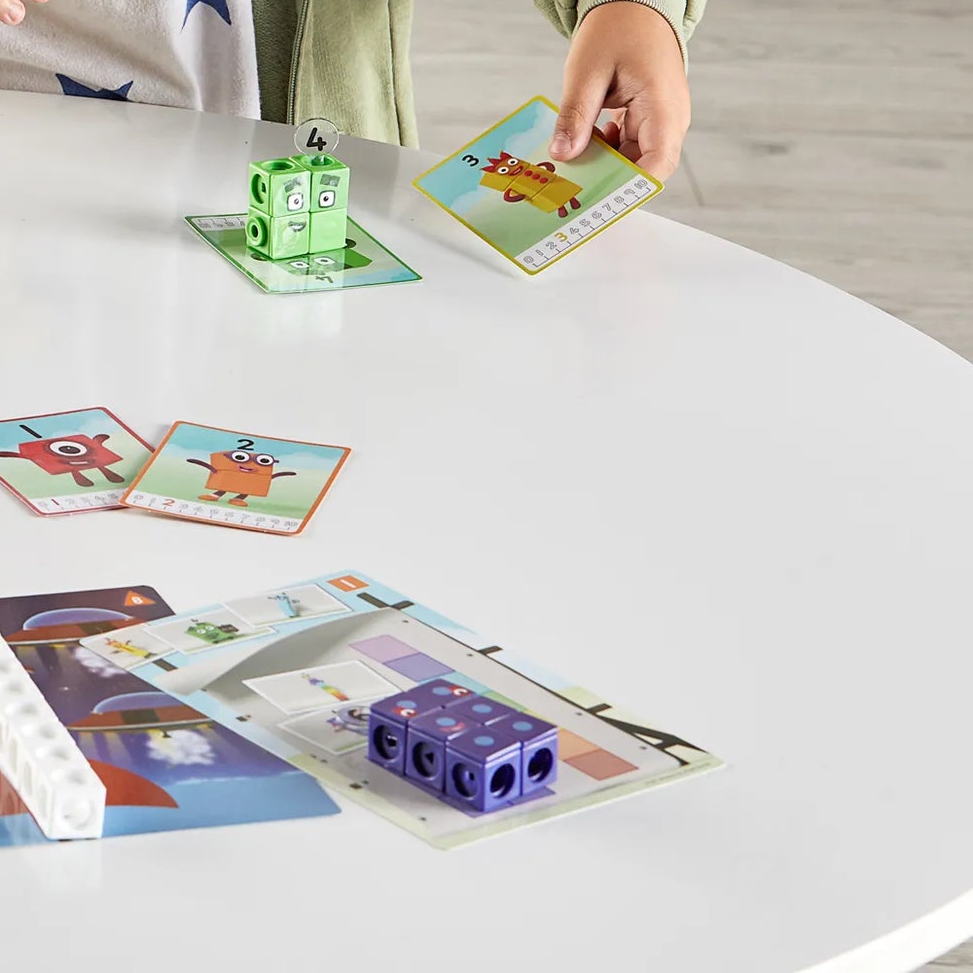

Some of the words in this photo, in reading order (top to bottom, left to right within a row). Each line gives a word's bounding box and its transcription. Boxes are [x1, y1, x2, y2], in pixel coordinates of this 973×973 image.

[306, 127, 327, 151] 4
[461, 154, 479, 167] 3
[524, 255, 534, 264] 0
[546, 242, 558, 250] 2
[554, 232, 568, 242] 3
[579, 218, 590, 227] 5
[592, 210, 602, 220] 6
[602, 202, 612, 212] 7
[614, 195, 624, 204] 8
[634, 179, 648, 189] 10
[18, 424, 42, 438] 1
[237, 438, 254, 450] 2
[162, 498, 175, 506] 2
